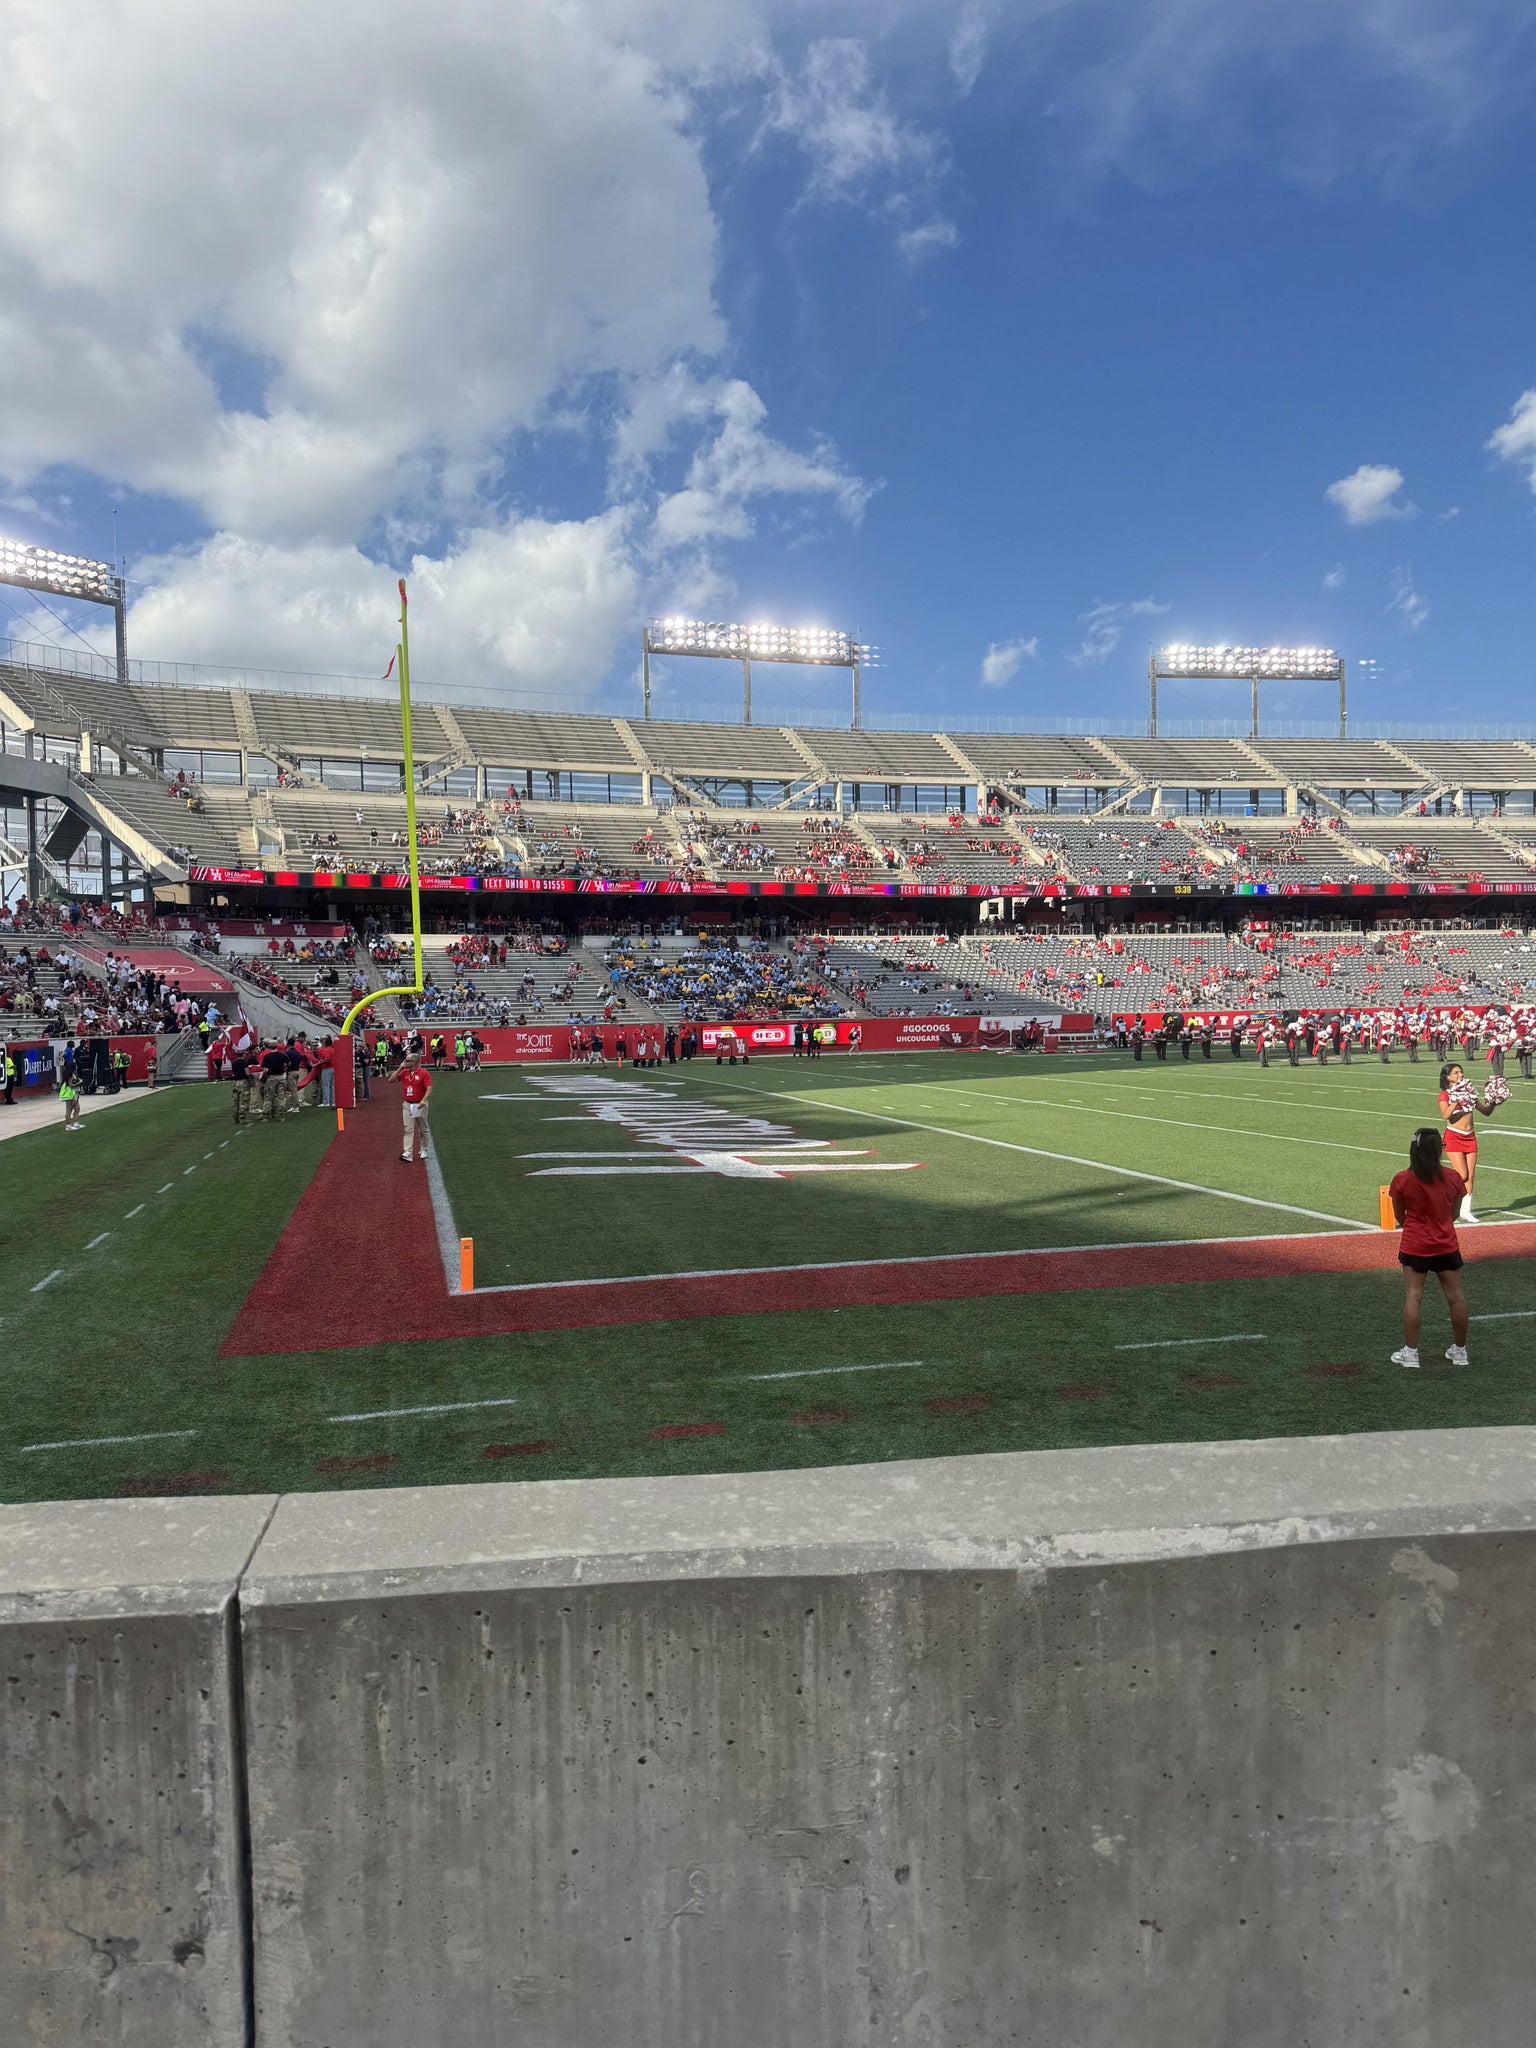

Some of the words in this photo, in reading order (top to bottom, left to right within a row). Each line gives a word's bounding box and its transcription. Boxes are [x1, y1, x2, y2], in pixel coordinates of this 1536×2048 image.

[484, 879, 502, 888] TEXT
[506, 879, 528, 889] UH100
[532, 880, 540, 889] TO
[544, 880, 565, 890] 51555
[1480, 884, 1493, 892] TEXT
[900, 885, 915, 894] TEXT
[918, 885, 936, 895] UH100
[940, 886, 946, 895] TO
[355, 904, 408, 913] MARKET
[903, 1024, 950, 1033] #GOCOOGS
[526, 1034, 552, 1047] JOINT
[896, 1035, 940, 1043] UHCOUGARS
[511, 1100, 925, 1179] Houston
